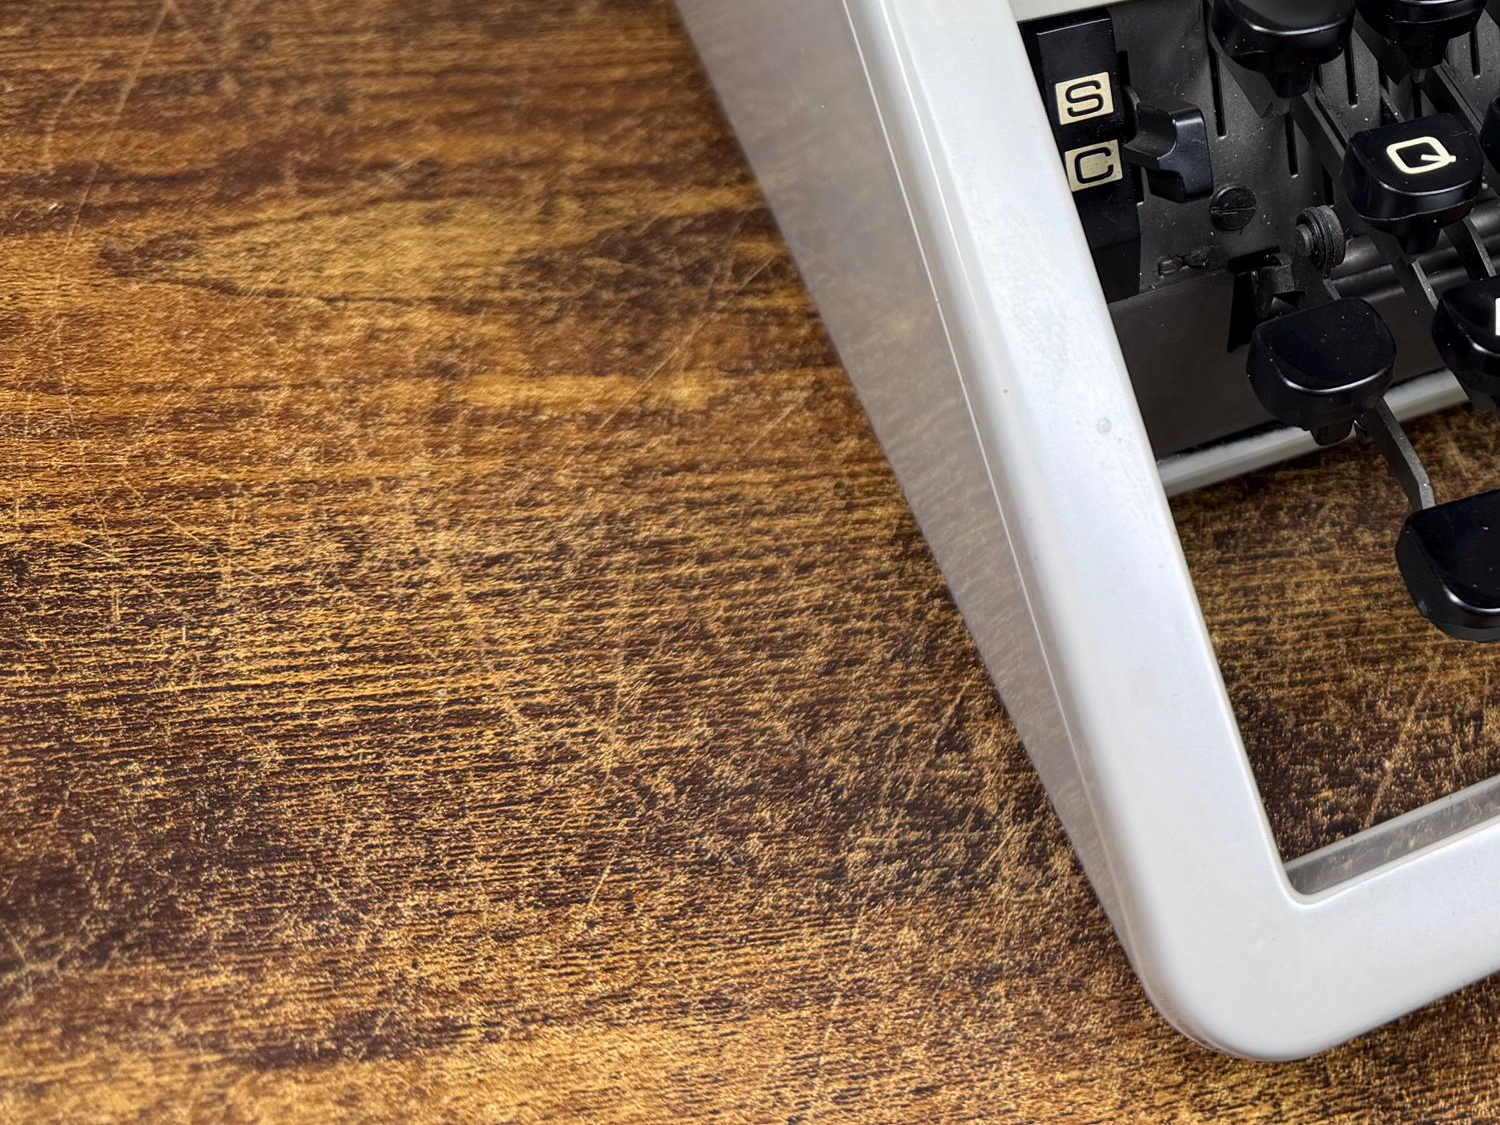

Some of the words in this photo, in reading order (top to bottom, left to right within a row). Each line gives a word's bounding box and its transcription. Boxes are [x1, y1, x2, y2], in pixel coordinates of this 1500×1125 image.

[1065, 79, 1104, 118] S
[1073, 145, 1115, 184] C
[1386, 136, 1457, 175] Q
